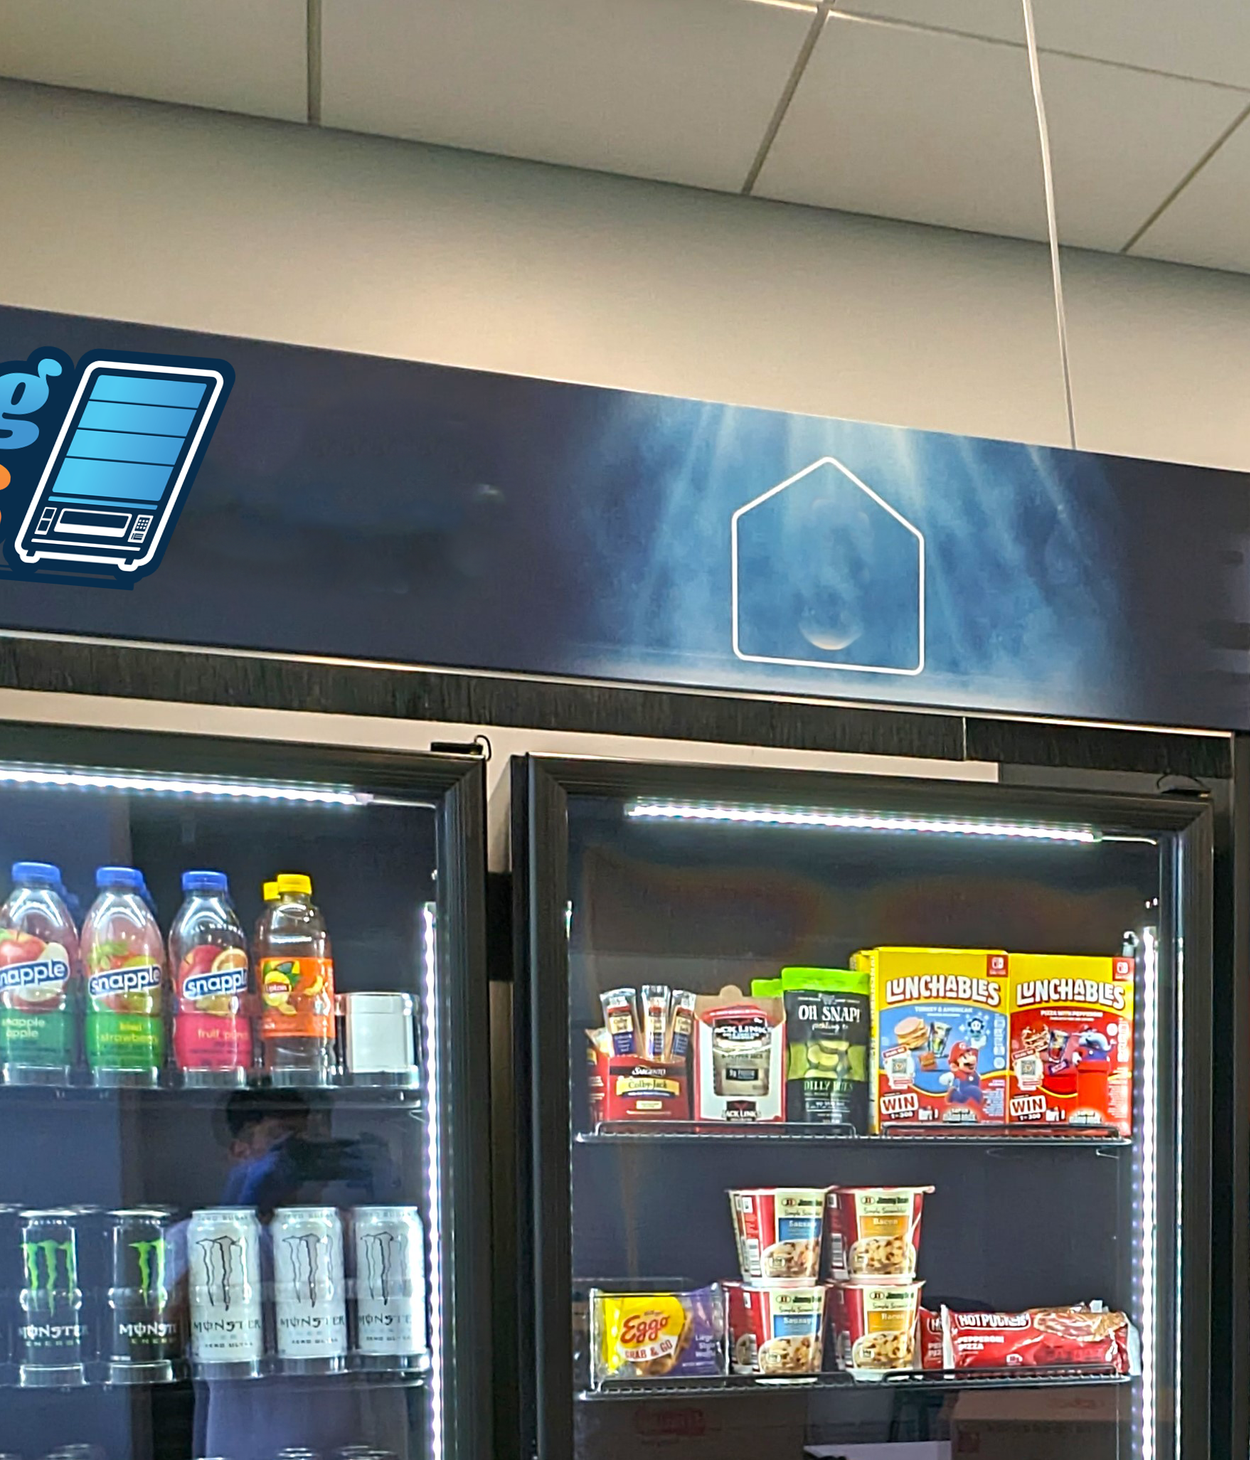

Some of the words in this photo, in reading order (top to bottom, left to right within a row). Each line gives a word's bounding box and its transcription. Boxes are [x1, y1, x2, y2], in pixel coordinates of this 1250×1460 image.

[89, 965, 162, 997] snapple
[884, 974, 1001, 1006] LUNCHABLES
[1016, 978, 1126, 1011] LUNCHABLES
[798, 1004, 818, 1022] OH
[821, 1006, 861, 1024] SNAP!
[882, 1097, 915, 1112] WIN
[1011, 1098, 1043, 1113] WIN
[873, 1218, 898, 1226] Bacon
[193, 1318, 262, 1333] MONSTER
[279, 1314, 346, 1329] MONSTER
[958, 1314, 980, 1327] HOT
[620, 1314, 671, 1344] Eggo
[957, 1336, 1005, 1344] PEPPERONI
[958, 1343, 984, 1351] PIZZA
[650, 1347, 659, 1357] &
[660, 1339, 673, 1353] GO
